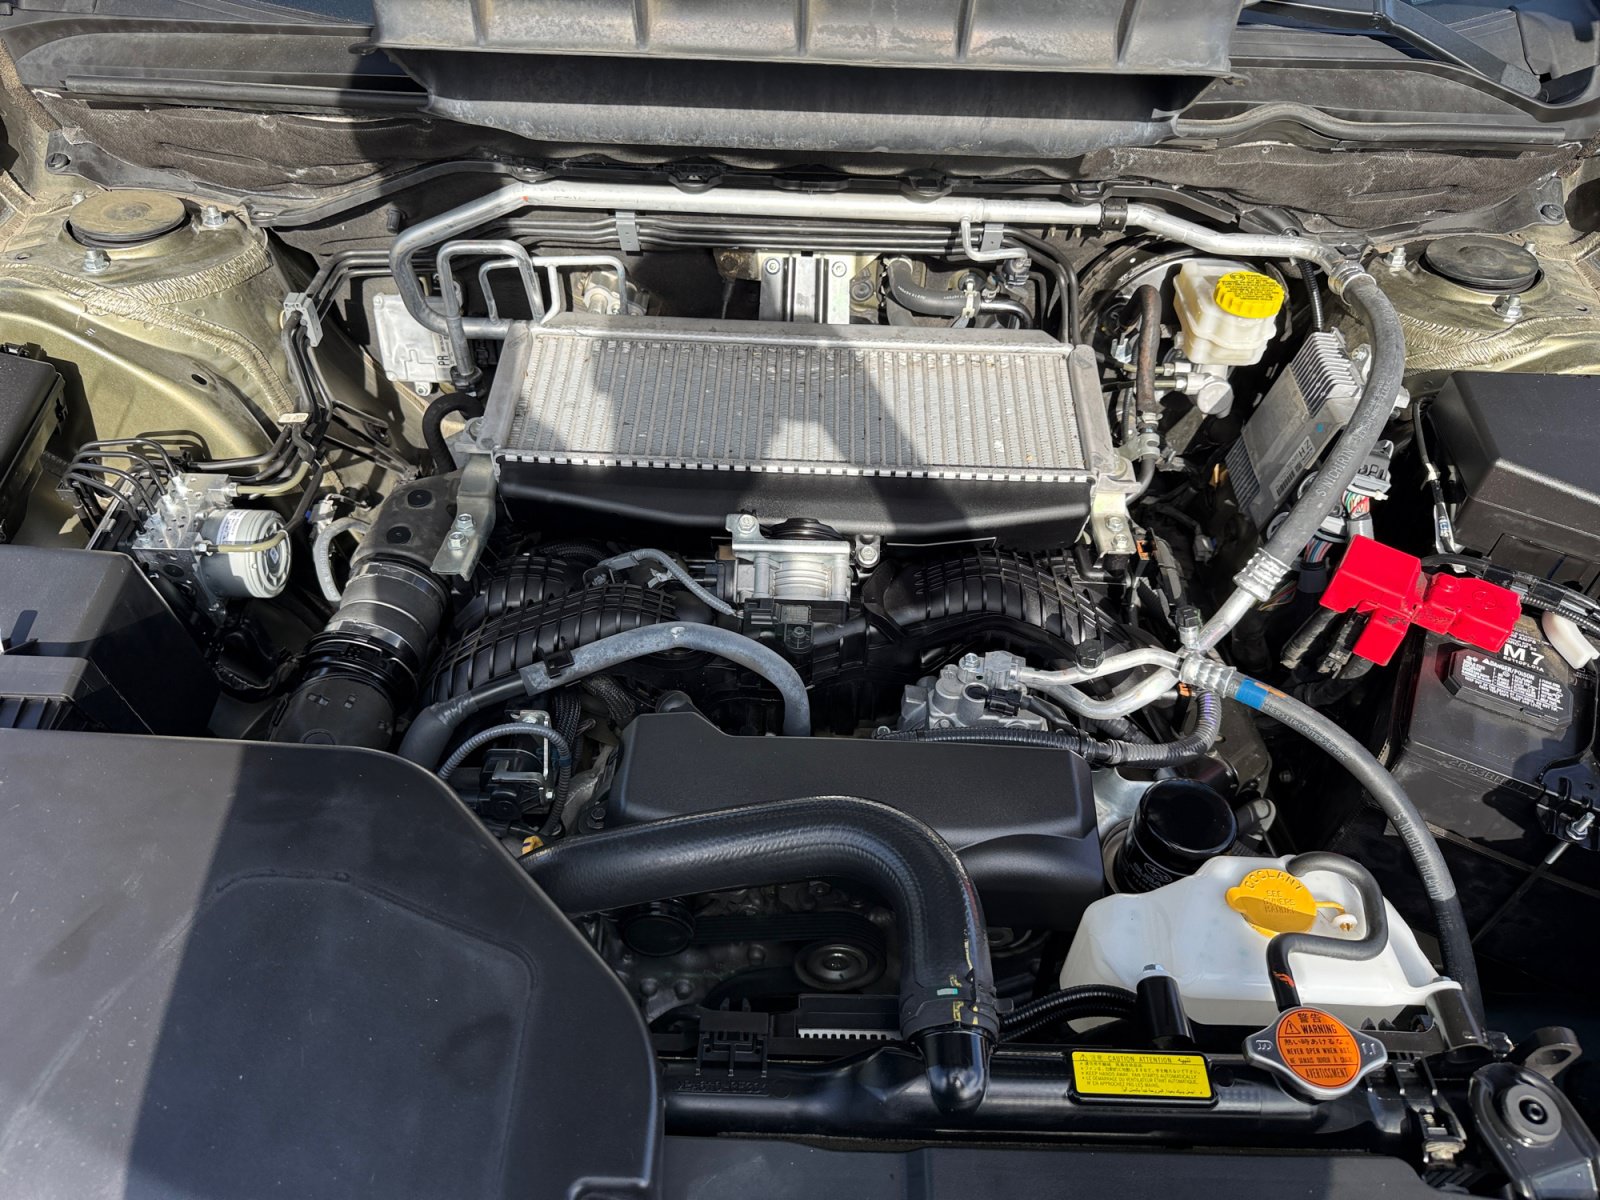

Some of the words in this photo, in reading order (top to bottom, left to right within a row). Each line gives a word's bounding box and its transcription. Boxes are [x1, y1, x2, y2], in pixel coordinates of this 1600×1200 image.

[437, 355, 450, 366] PR
[1245, 870, 1304, 889] COOLANT
[1298, 1013, 1321, 1023] 警告
[1301, 1024, 1337, 1034] WARNING
[1286, 1047, 1304, 1055] NEVER
[1306, 1047, 1320, 1055] OPEN
